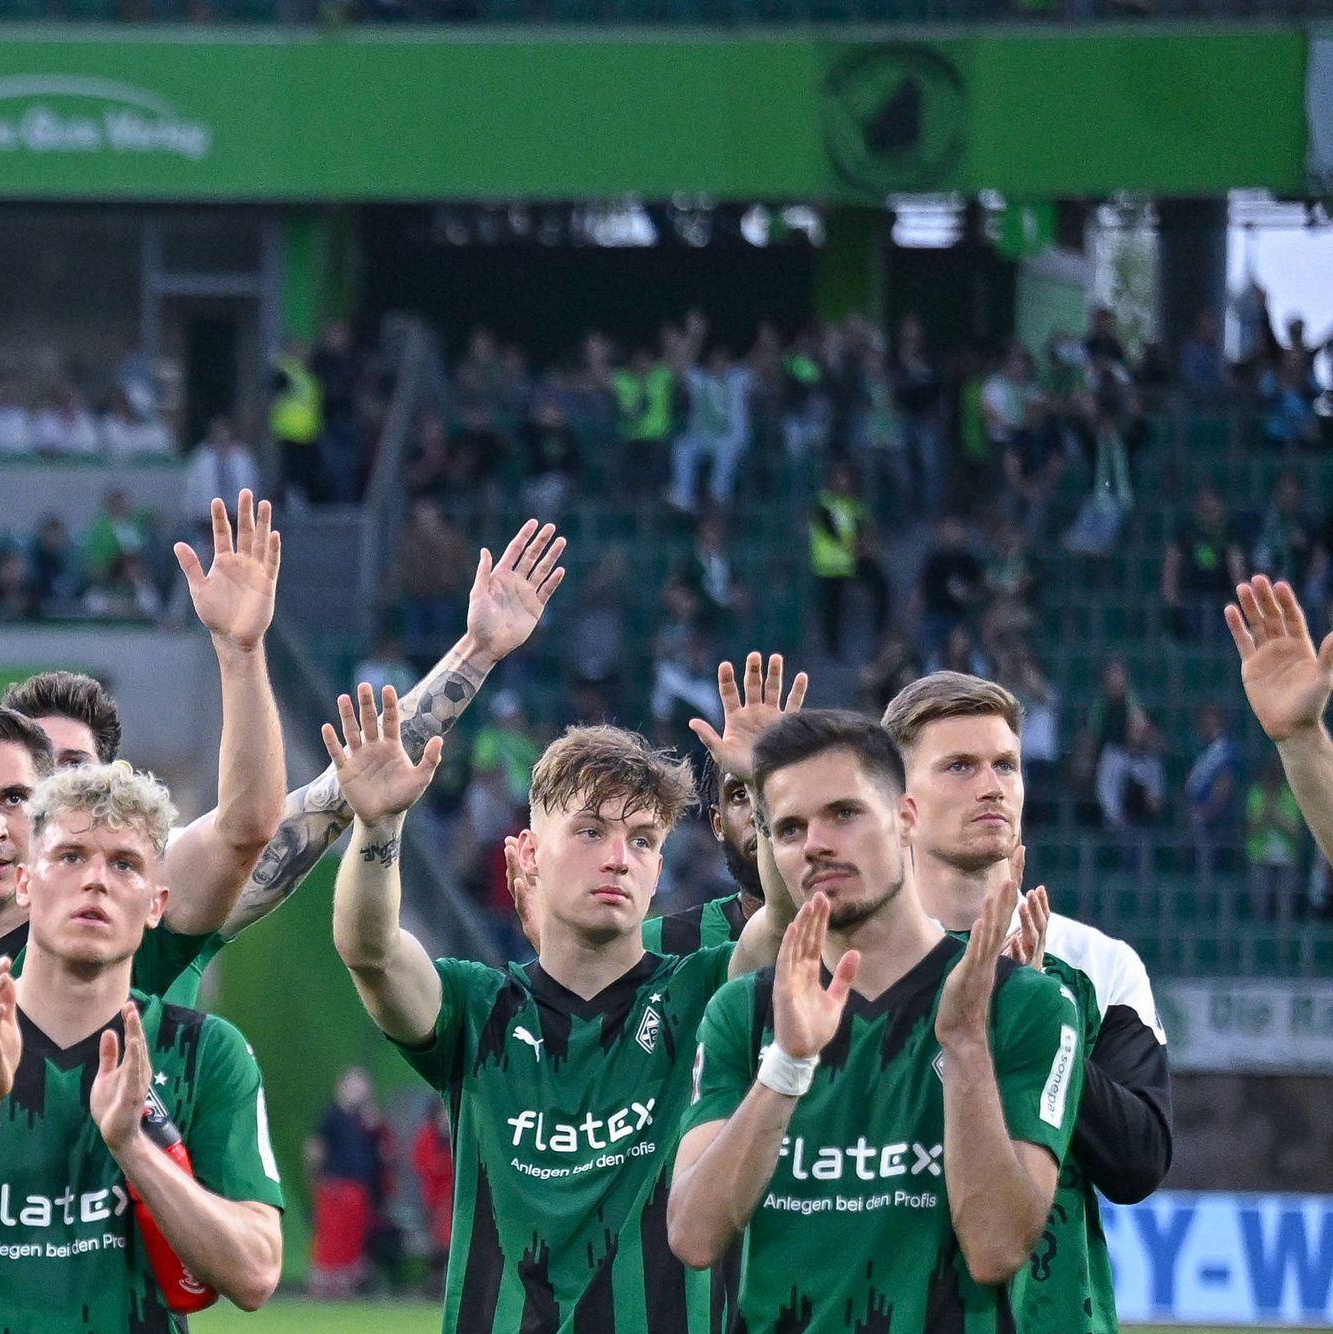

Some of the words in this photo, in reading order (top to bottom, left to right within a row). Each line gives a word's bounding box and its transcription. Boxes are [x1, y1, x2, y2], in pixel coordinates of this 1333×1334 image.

[507, 1098, 656, 1152] flatex
[511, 1157, 570, 1180] Anlegen
[596, 1154, 624, 1168] den
[763, 1193, 831, 1215] Anlegen
[836, 1195, 862, 1211] bei
[865, 1194, 891, 1210] den
[895, 1191, 936, 1208] Profis
[46, 1242, 70, 1257] bei
[71, 1235, 99, 1255] den
[1103, 1207, 1333, 1308] Y-W
